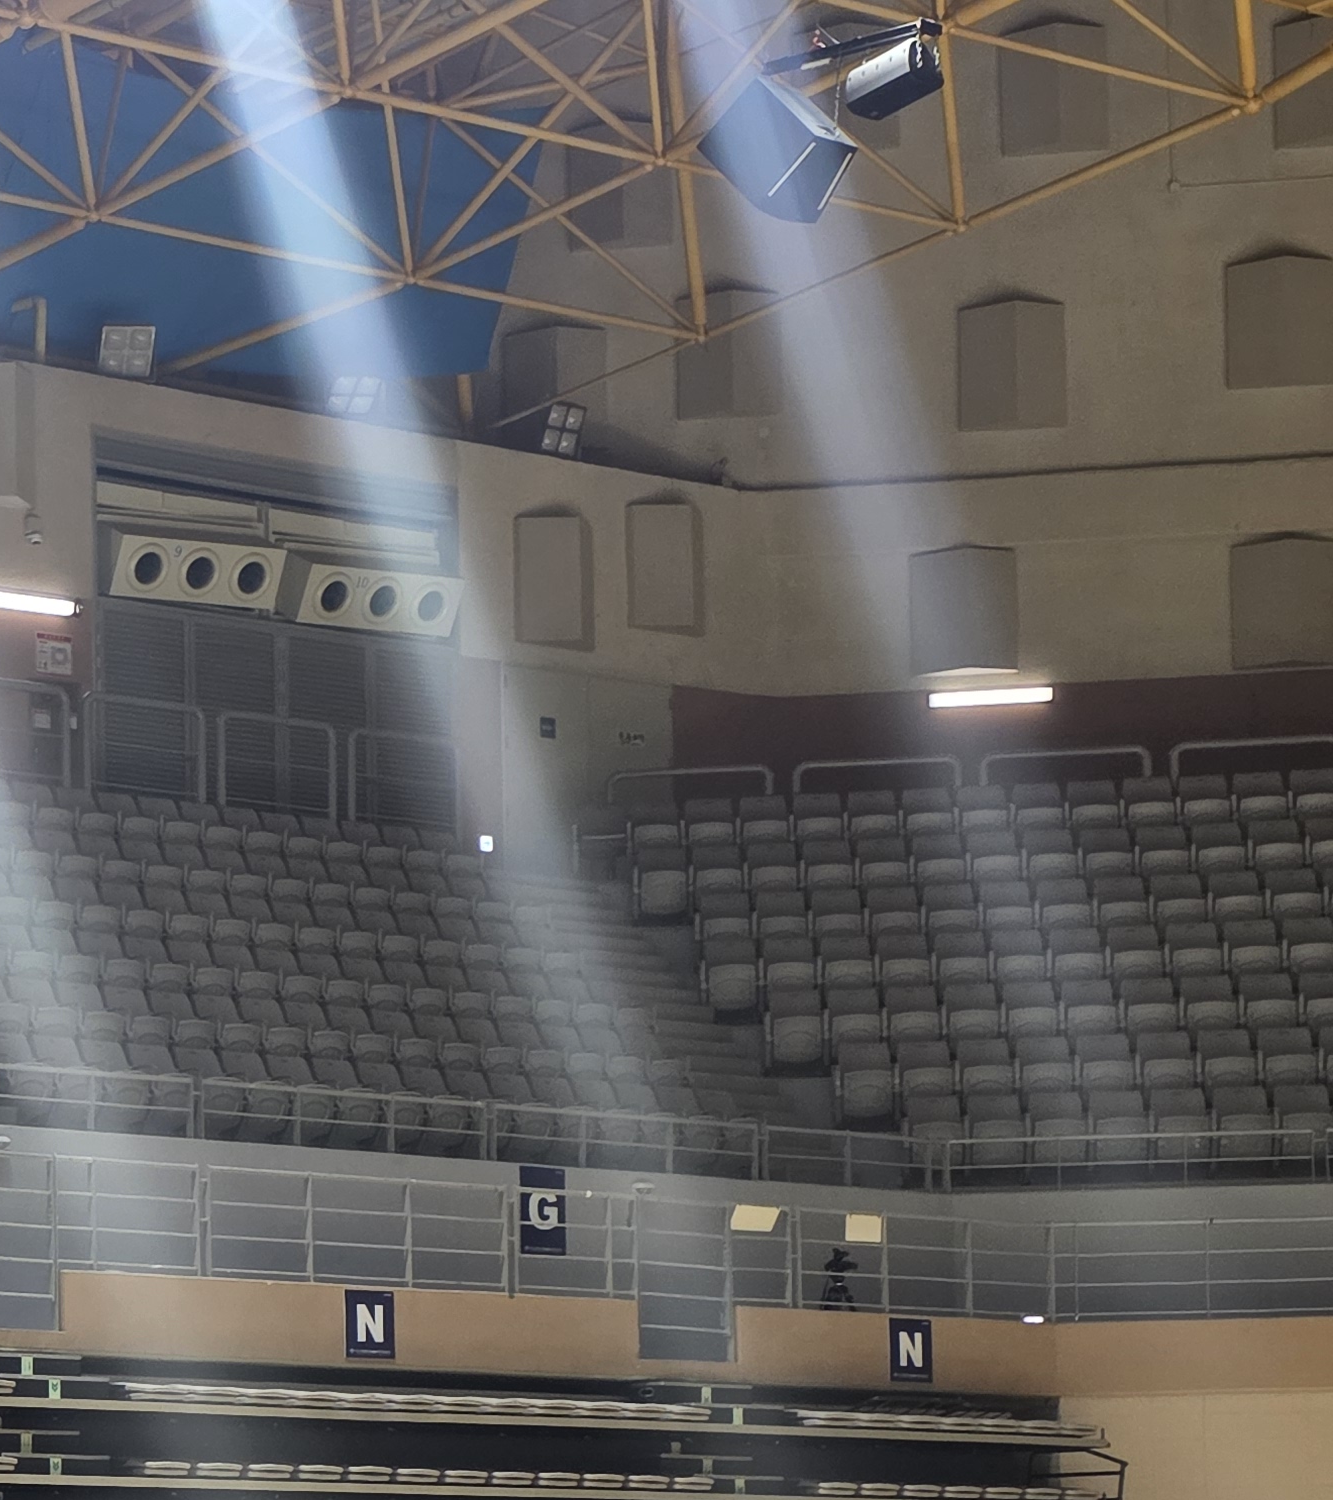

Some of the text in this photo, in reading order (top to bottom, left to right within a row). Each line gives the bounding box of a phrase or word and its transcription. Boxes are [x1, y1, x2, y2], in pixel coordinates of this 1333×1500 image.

[529, 1192, 559, 1230] G
[356, 1304, 384, 1343] N
[898, 1331, 923, 1368] N
